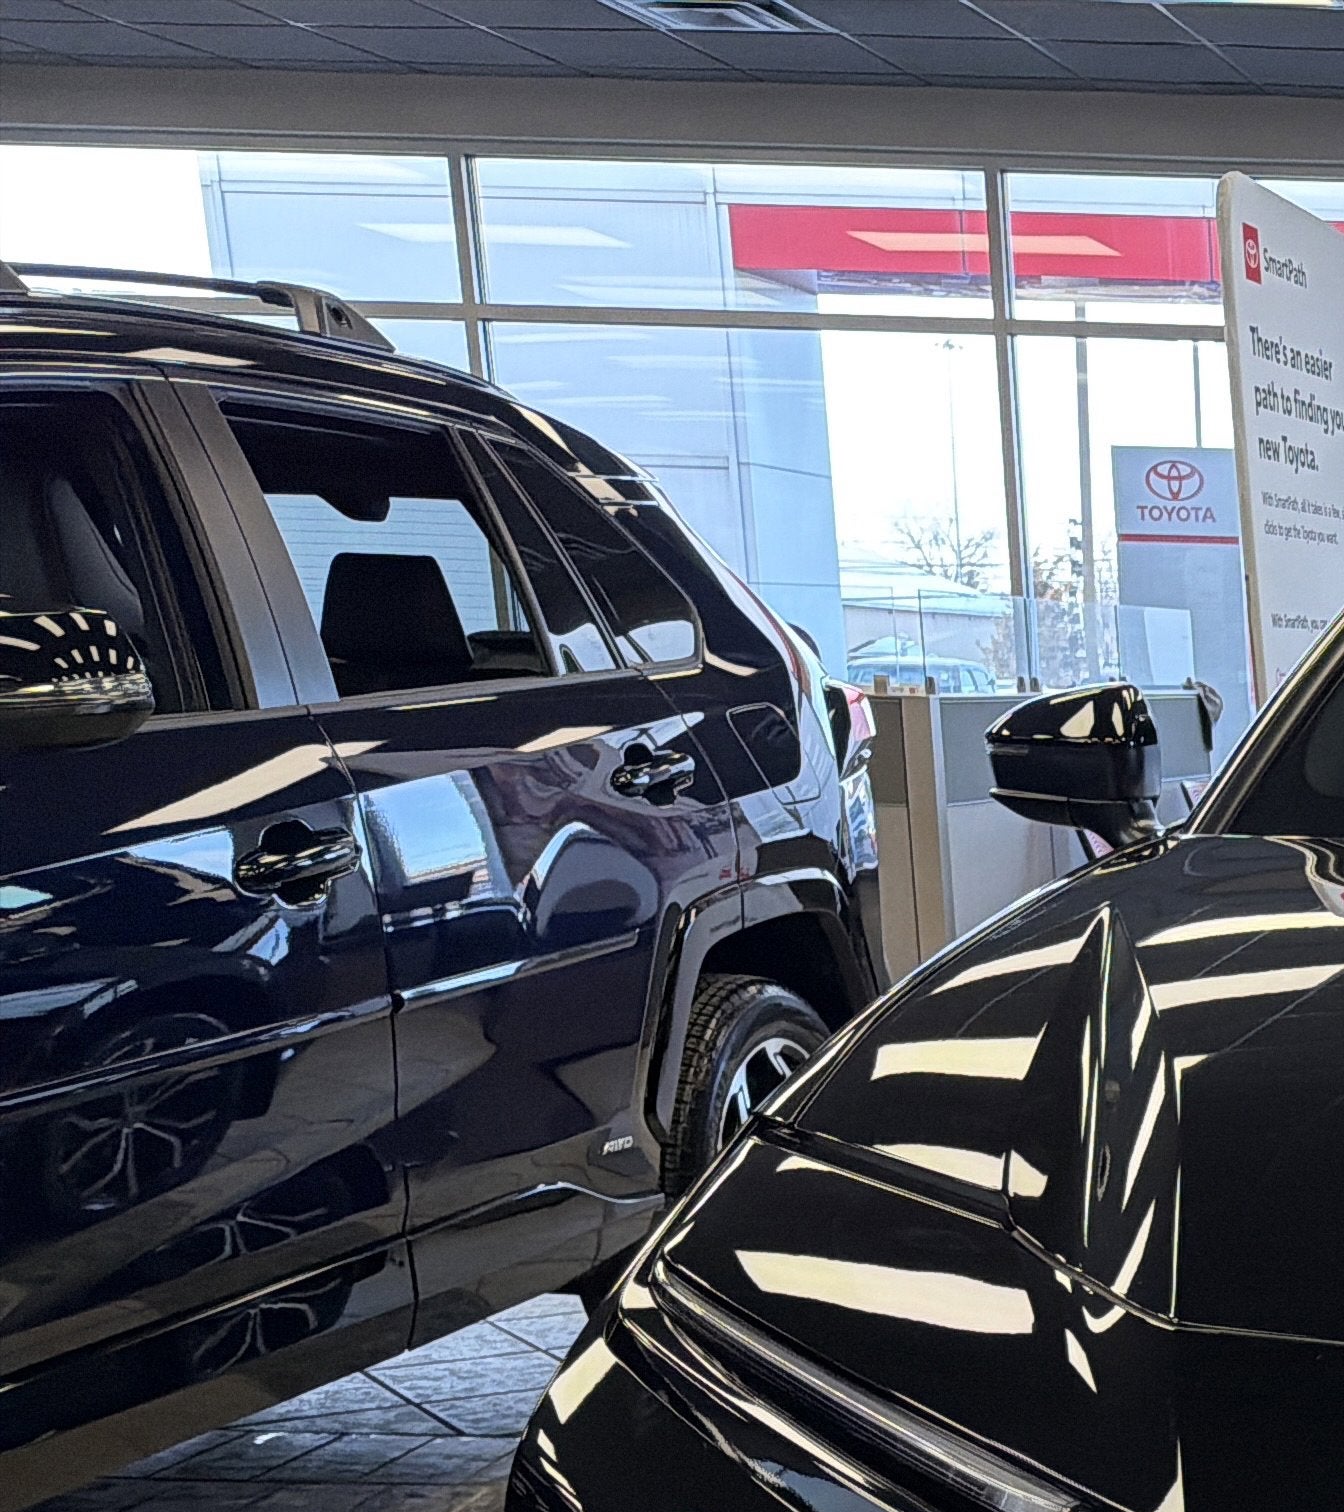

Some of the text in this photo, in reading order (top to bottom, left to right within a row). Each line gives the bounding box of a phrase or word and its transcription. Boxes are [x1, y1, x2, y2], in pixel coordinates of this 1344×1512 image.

[1263, 247, 1308, 289] SmartPath
[1249, 325, 1333, 381] There's an easier
[1254, 380, 1280, 416] path
[1280, 387, 1293, 417] to
[1293, 387, 1329, 435] finding
[1258, 434, 1319, 475] new Toyota.
[1136, 505, 1217, 523] TOYOTA
